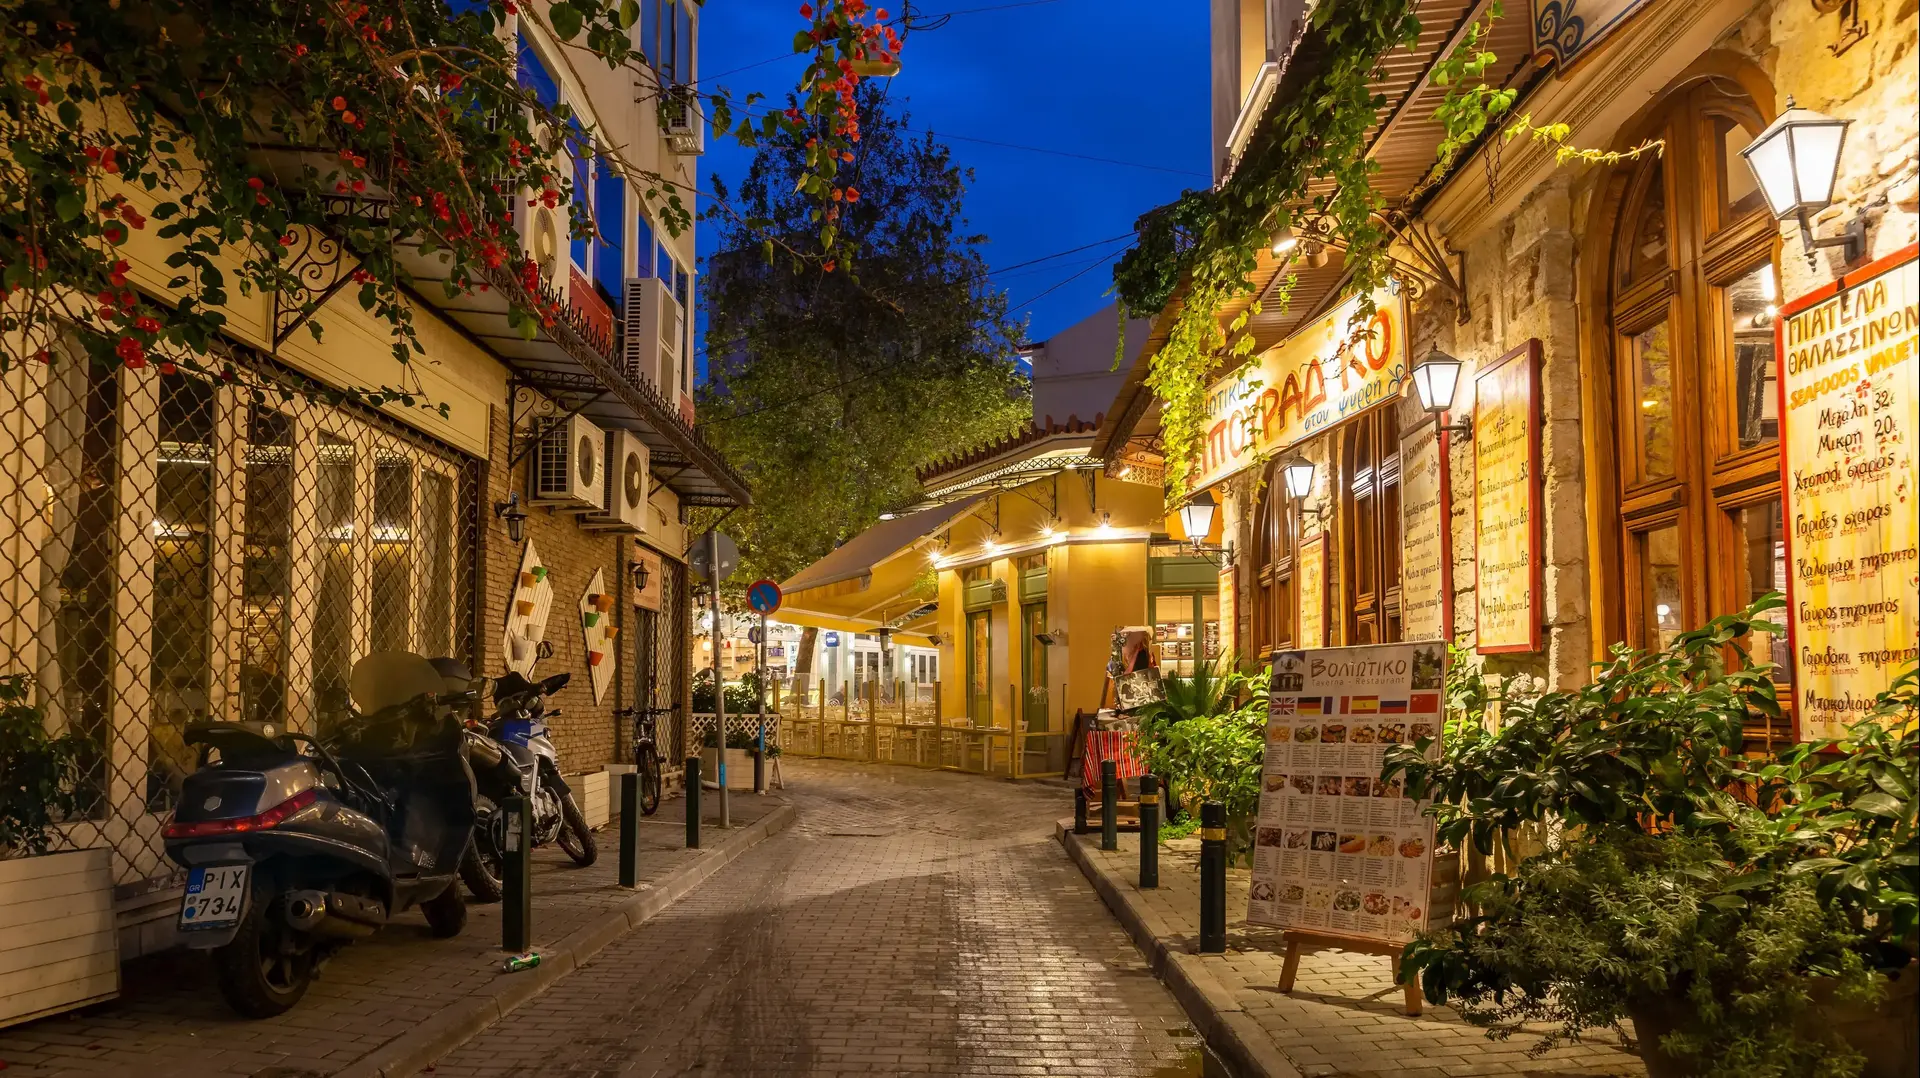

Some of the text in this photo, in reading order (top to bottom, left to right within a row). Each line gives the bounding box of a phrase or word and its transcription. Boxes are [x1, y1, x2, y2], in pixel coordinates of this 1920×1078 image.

[1788, 280, 1887, 347] ΠΙΑΤΕΛΑ
[1789, 362, 1860, 408] SEAFOODS
[1818, 400, 1868, 430] Μεγάλη
[1817, 431, 1864, 458] Μικρή
[1796, 510, 1838, 538] Γαρίδες
[1799, 600, 1837, 627] Γαύρος
[1312, 678, 1344, 687] Taverna
[1355, 677, 1405, 685] Restaurant
[1804, 688, 1879, 715] Μπακαλιάρο
[189, 884, 200, 892] GR
[198, 896, 237, 916] 734
